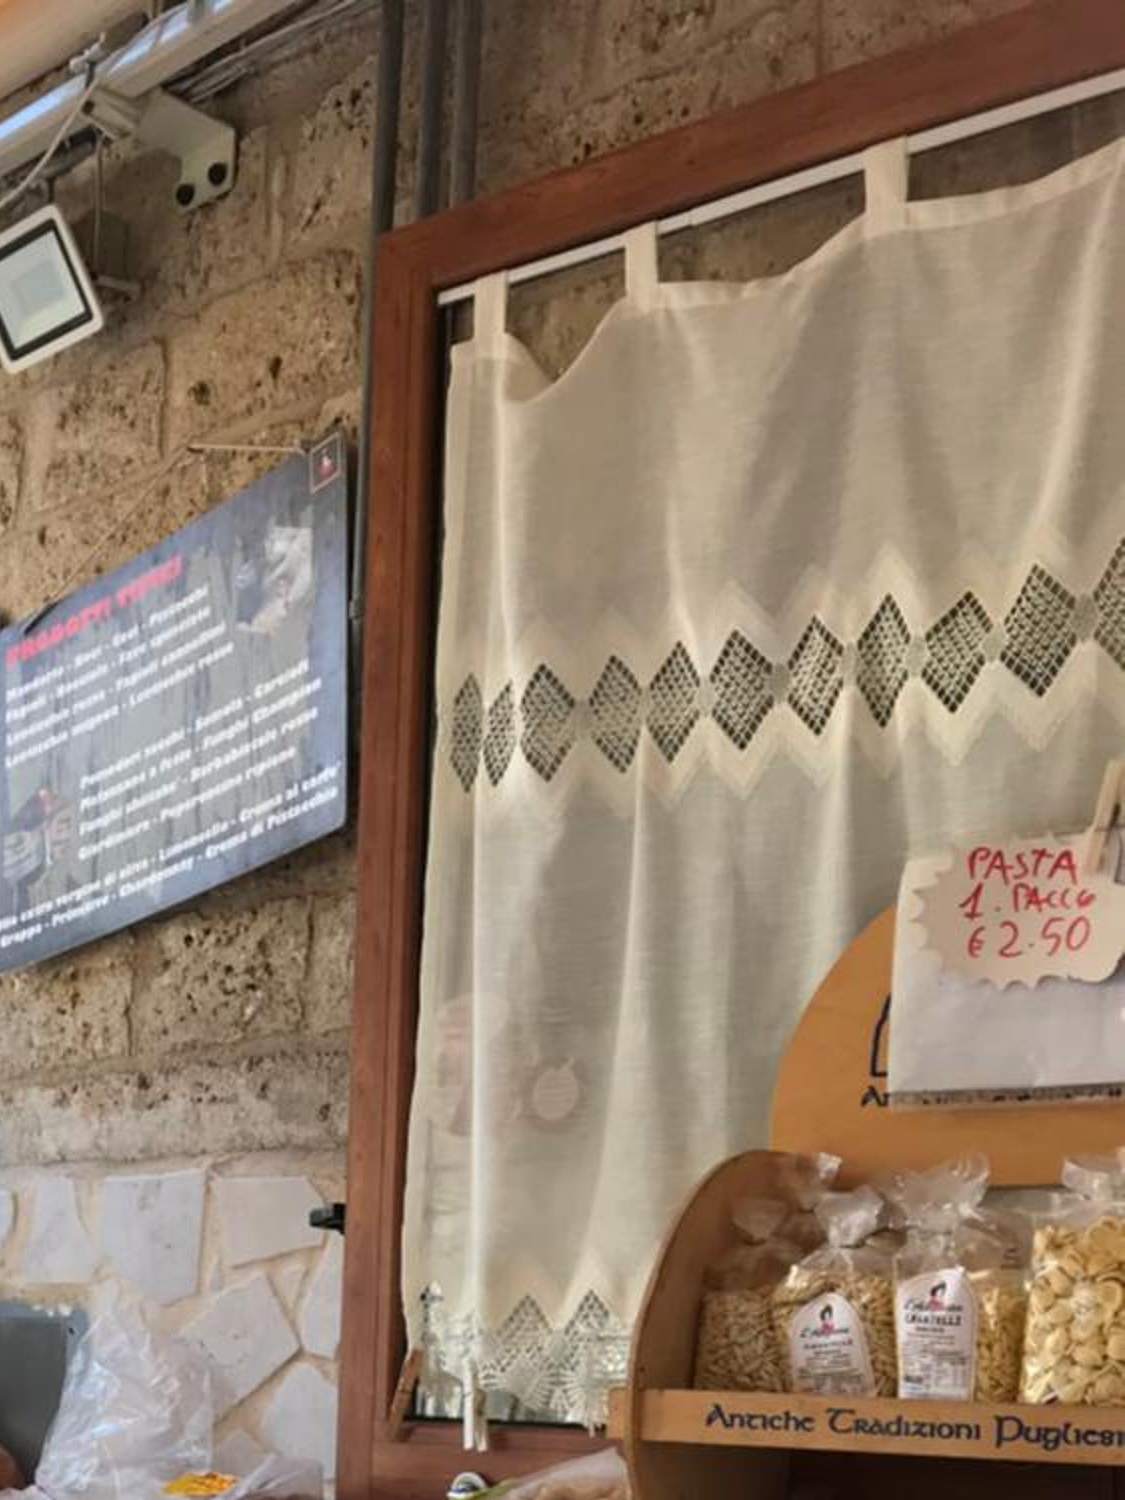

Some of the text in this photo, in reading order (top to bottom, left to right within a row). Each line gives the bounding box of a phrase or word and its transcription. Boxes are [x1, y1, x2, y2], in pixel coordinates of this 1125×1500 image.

[5, 597, 111, 669] PRODOTTI
[967, 848, 1077, 885] PASTA
[706, 1404, 1125, 1451] Antiche Tradizioni Pugliesi
